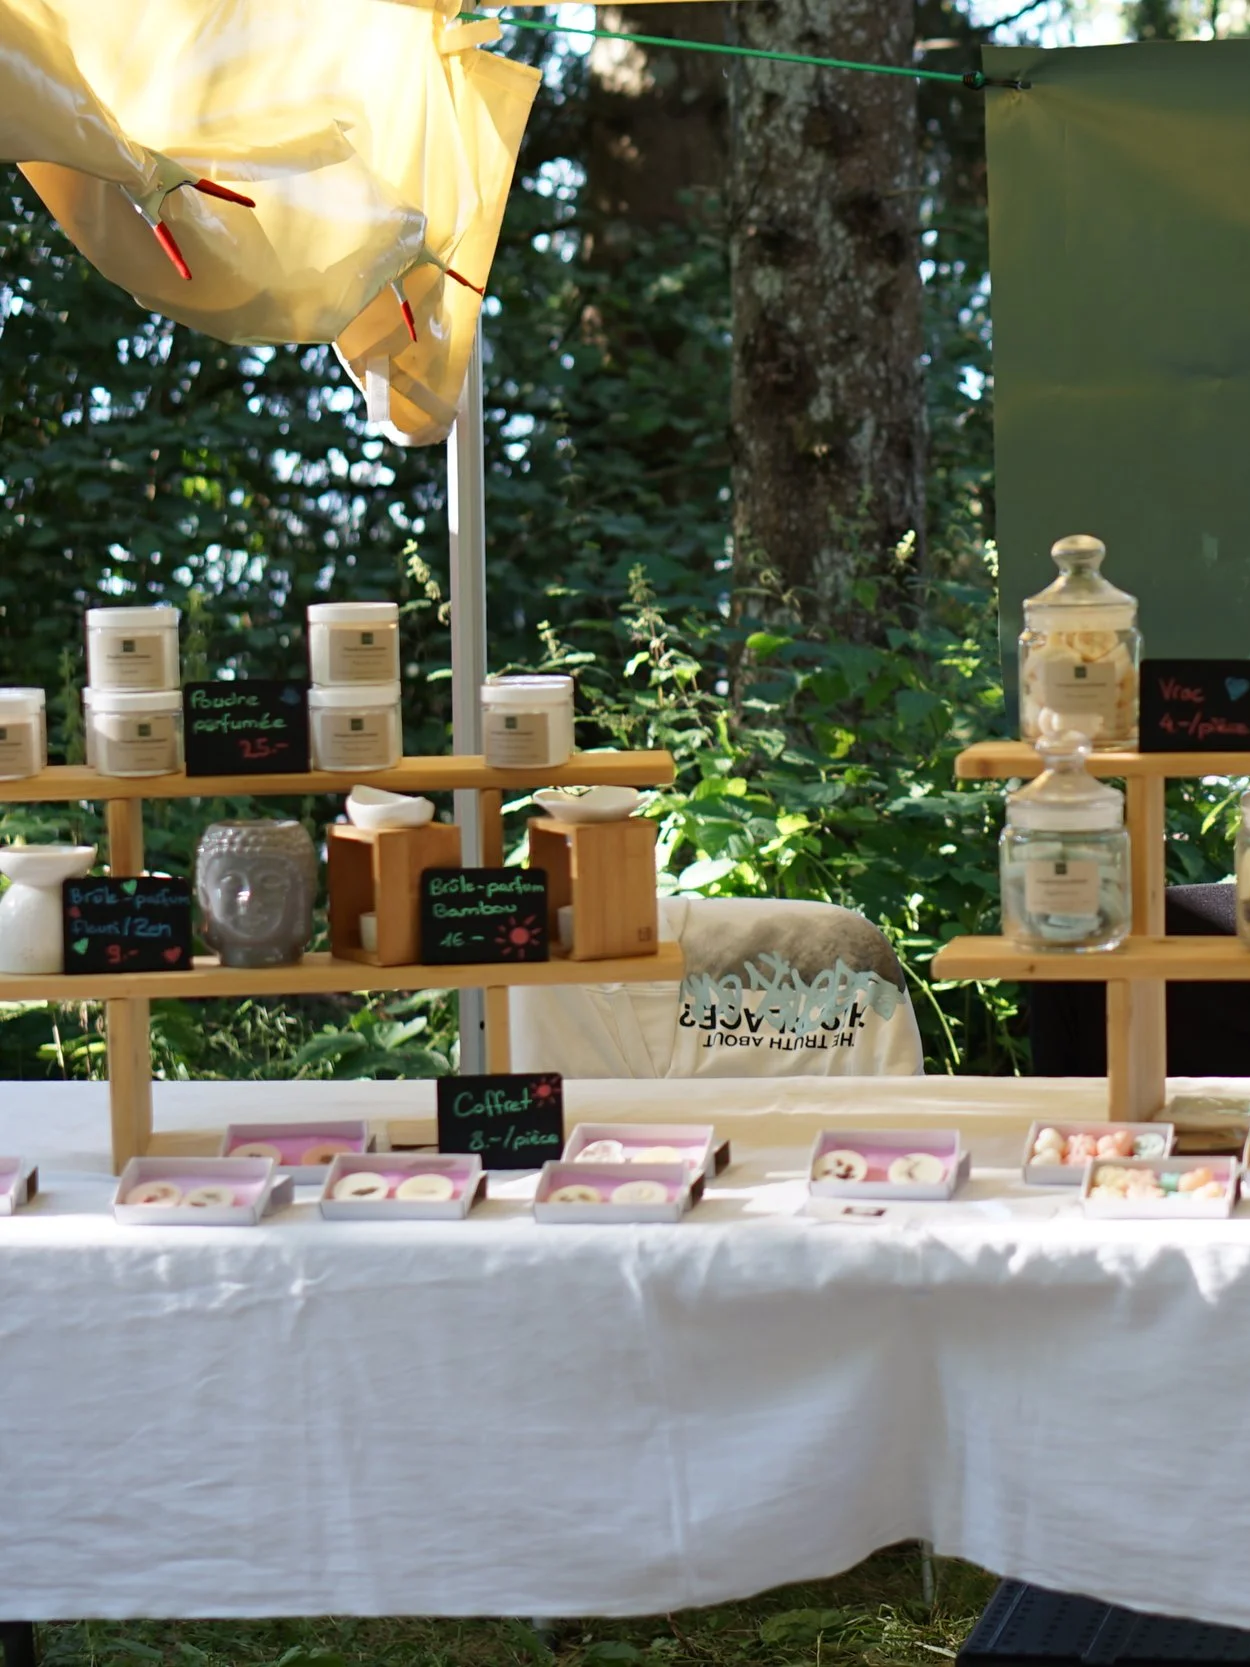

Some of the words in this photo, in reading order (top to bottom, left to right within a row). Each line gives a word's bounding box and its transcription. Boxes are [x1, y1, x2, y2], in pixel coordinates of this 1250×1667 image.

[190, 688, 261, 710] Poudre
[192, 711, 288, 735] parfumée
[238, 736, 290, 759] 25.-
[432, 900, 519, 919] Bambou
[702, 1031, 765, 1048] ABOUT
[769, 1033, 828, 1051] TRUTH
[831, 1032, 855, 1048] HE
[452, 1086, 534, 1118] Coffret
